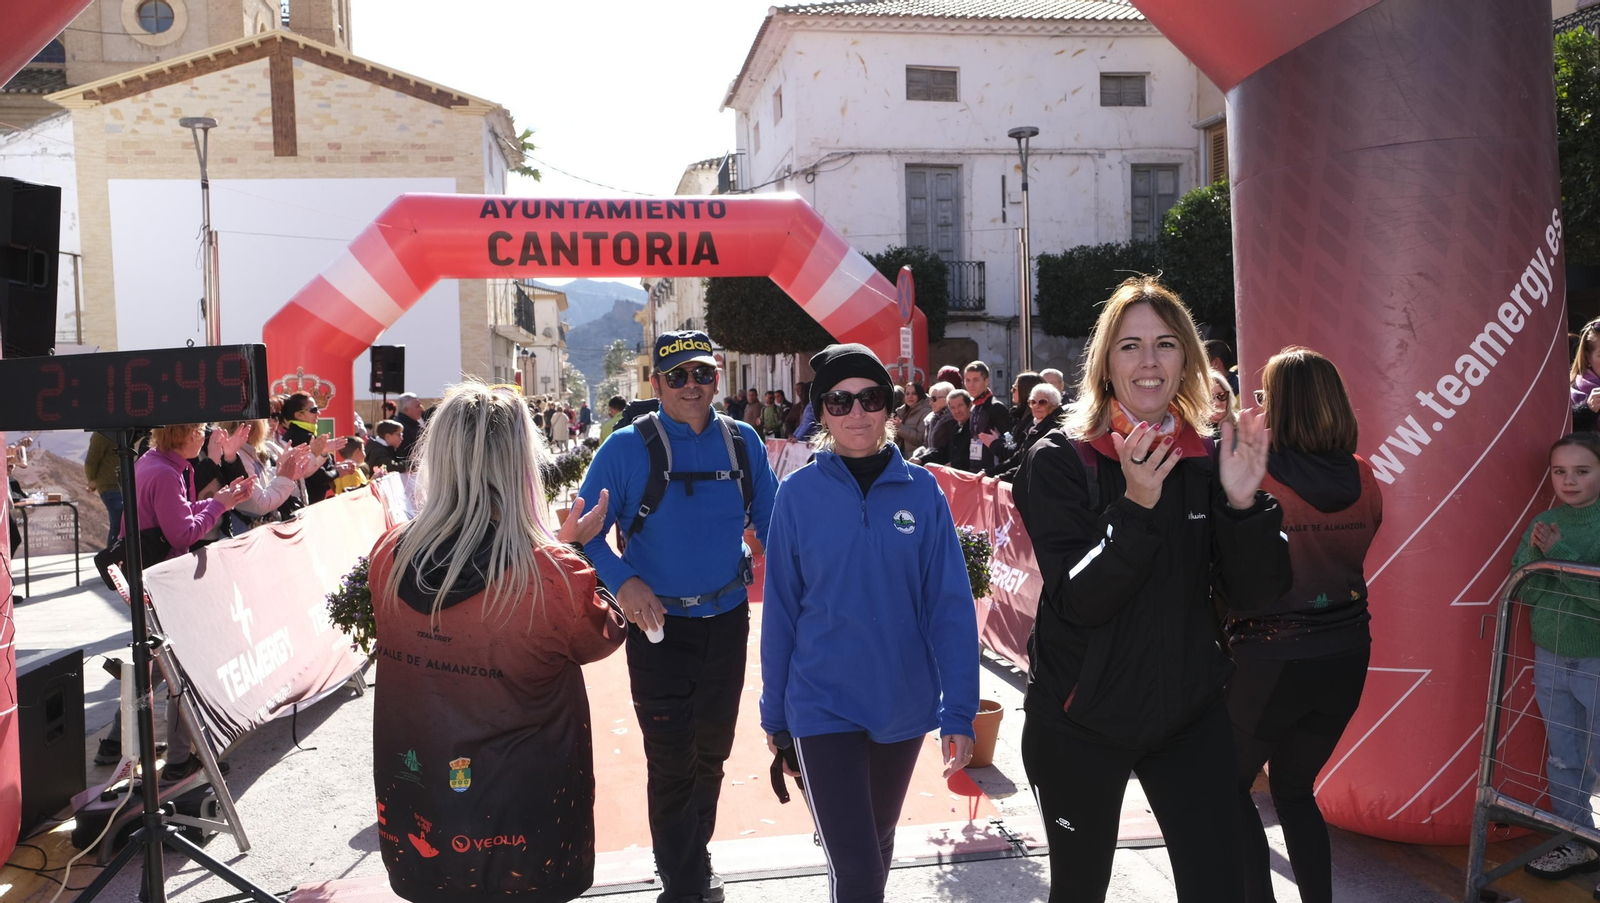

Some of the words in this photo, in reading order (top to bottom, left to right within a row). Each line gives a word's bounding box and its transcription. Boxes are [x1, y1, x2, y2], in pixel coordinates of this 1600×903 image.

[479, 199, 727, 219] AYUNTAMIENTO
[487, 230, 720, 266] CANTORIA
[659, 338, 711, 357] adidas
[1369, 207, 1562, 485] ww.teamergy.es
[36, 352, 247, 421] 2:16:49
[1282, 524, 1308, 532] VALLE
[216, 625, 294, 703] TEAMERGY
[376, 646, 402, 661] VALLE
[406, 654, 420, 666] DE
[425, 659, 504, 678] ALMANZORA
[473, 834, 526, 849] VEOLIA
